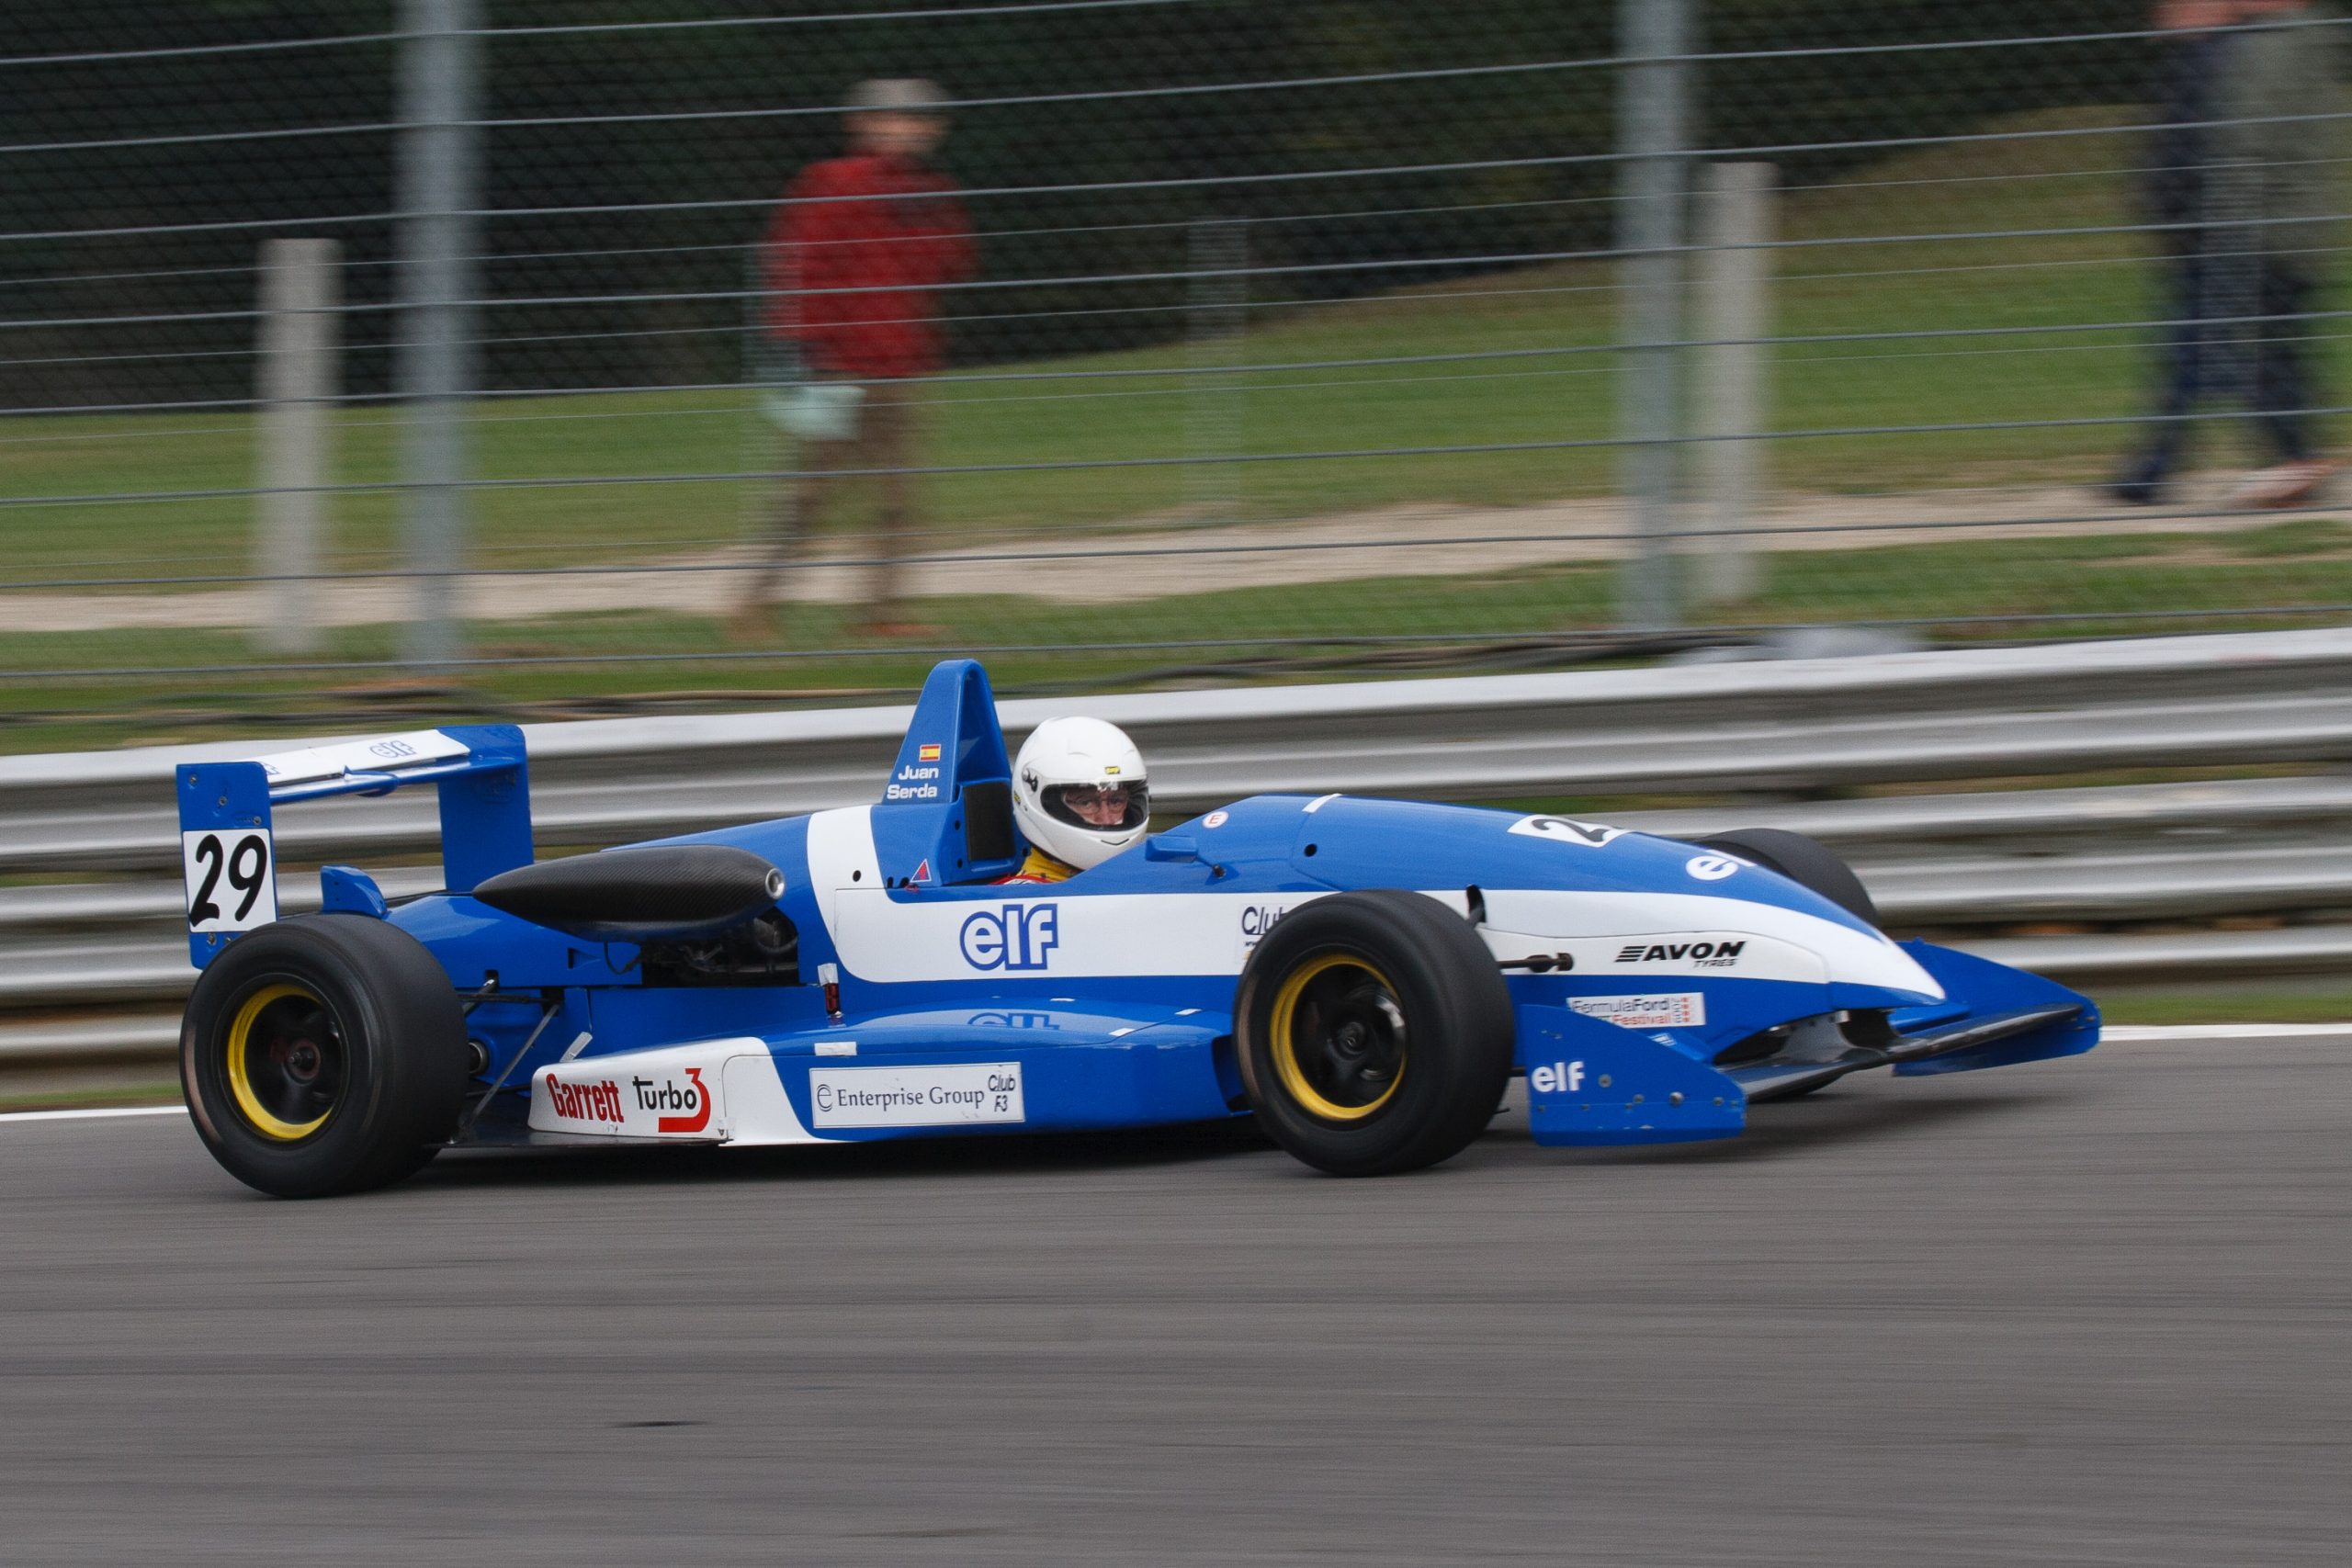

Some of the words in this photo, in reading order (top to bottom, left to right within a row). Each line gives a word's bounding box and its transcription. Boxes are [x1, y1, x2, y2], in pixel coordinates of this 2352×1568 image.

[898, 765, 939, 780] Juan
[887, 784, 938, 800] Serda
[1531, 818, 1624, 843] 2
[1686, 849, 1758, 880] el
[189, 833, 267, 927] 29
[959, 903, 1059, 971] elf
[1642, 941, 1747, 961] AVON
[1692, 958, 1737, 968] TYRES
[1611, 1013, 1671, 1025] Festival
[988, 1074, 1016, 1091] Club
[1532, 1061, 1586, 1093] elf
[545, 1073, 625, 1122] Garrett
[658, 1067, 711, 1133] 3
[837, 1088, 923, 1111] Enterprise
[929, 1087, 985, 1110] Group
[994, 1095, 1009, 1112] F3
